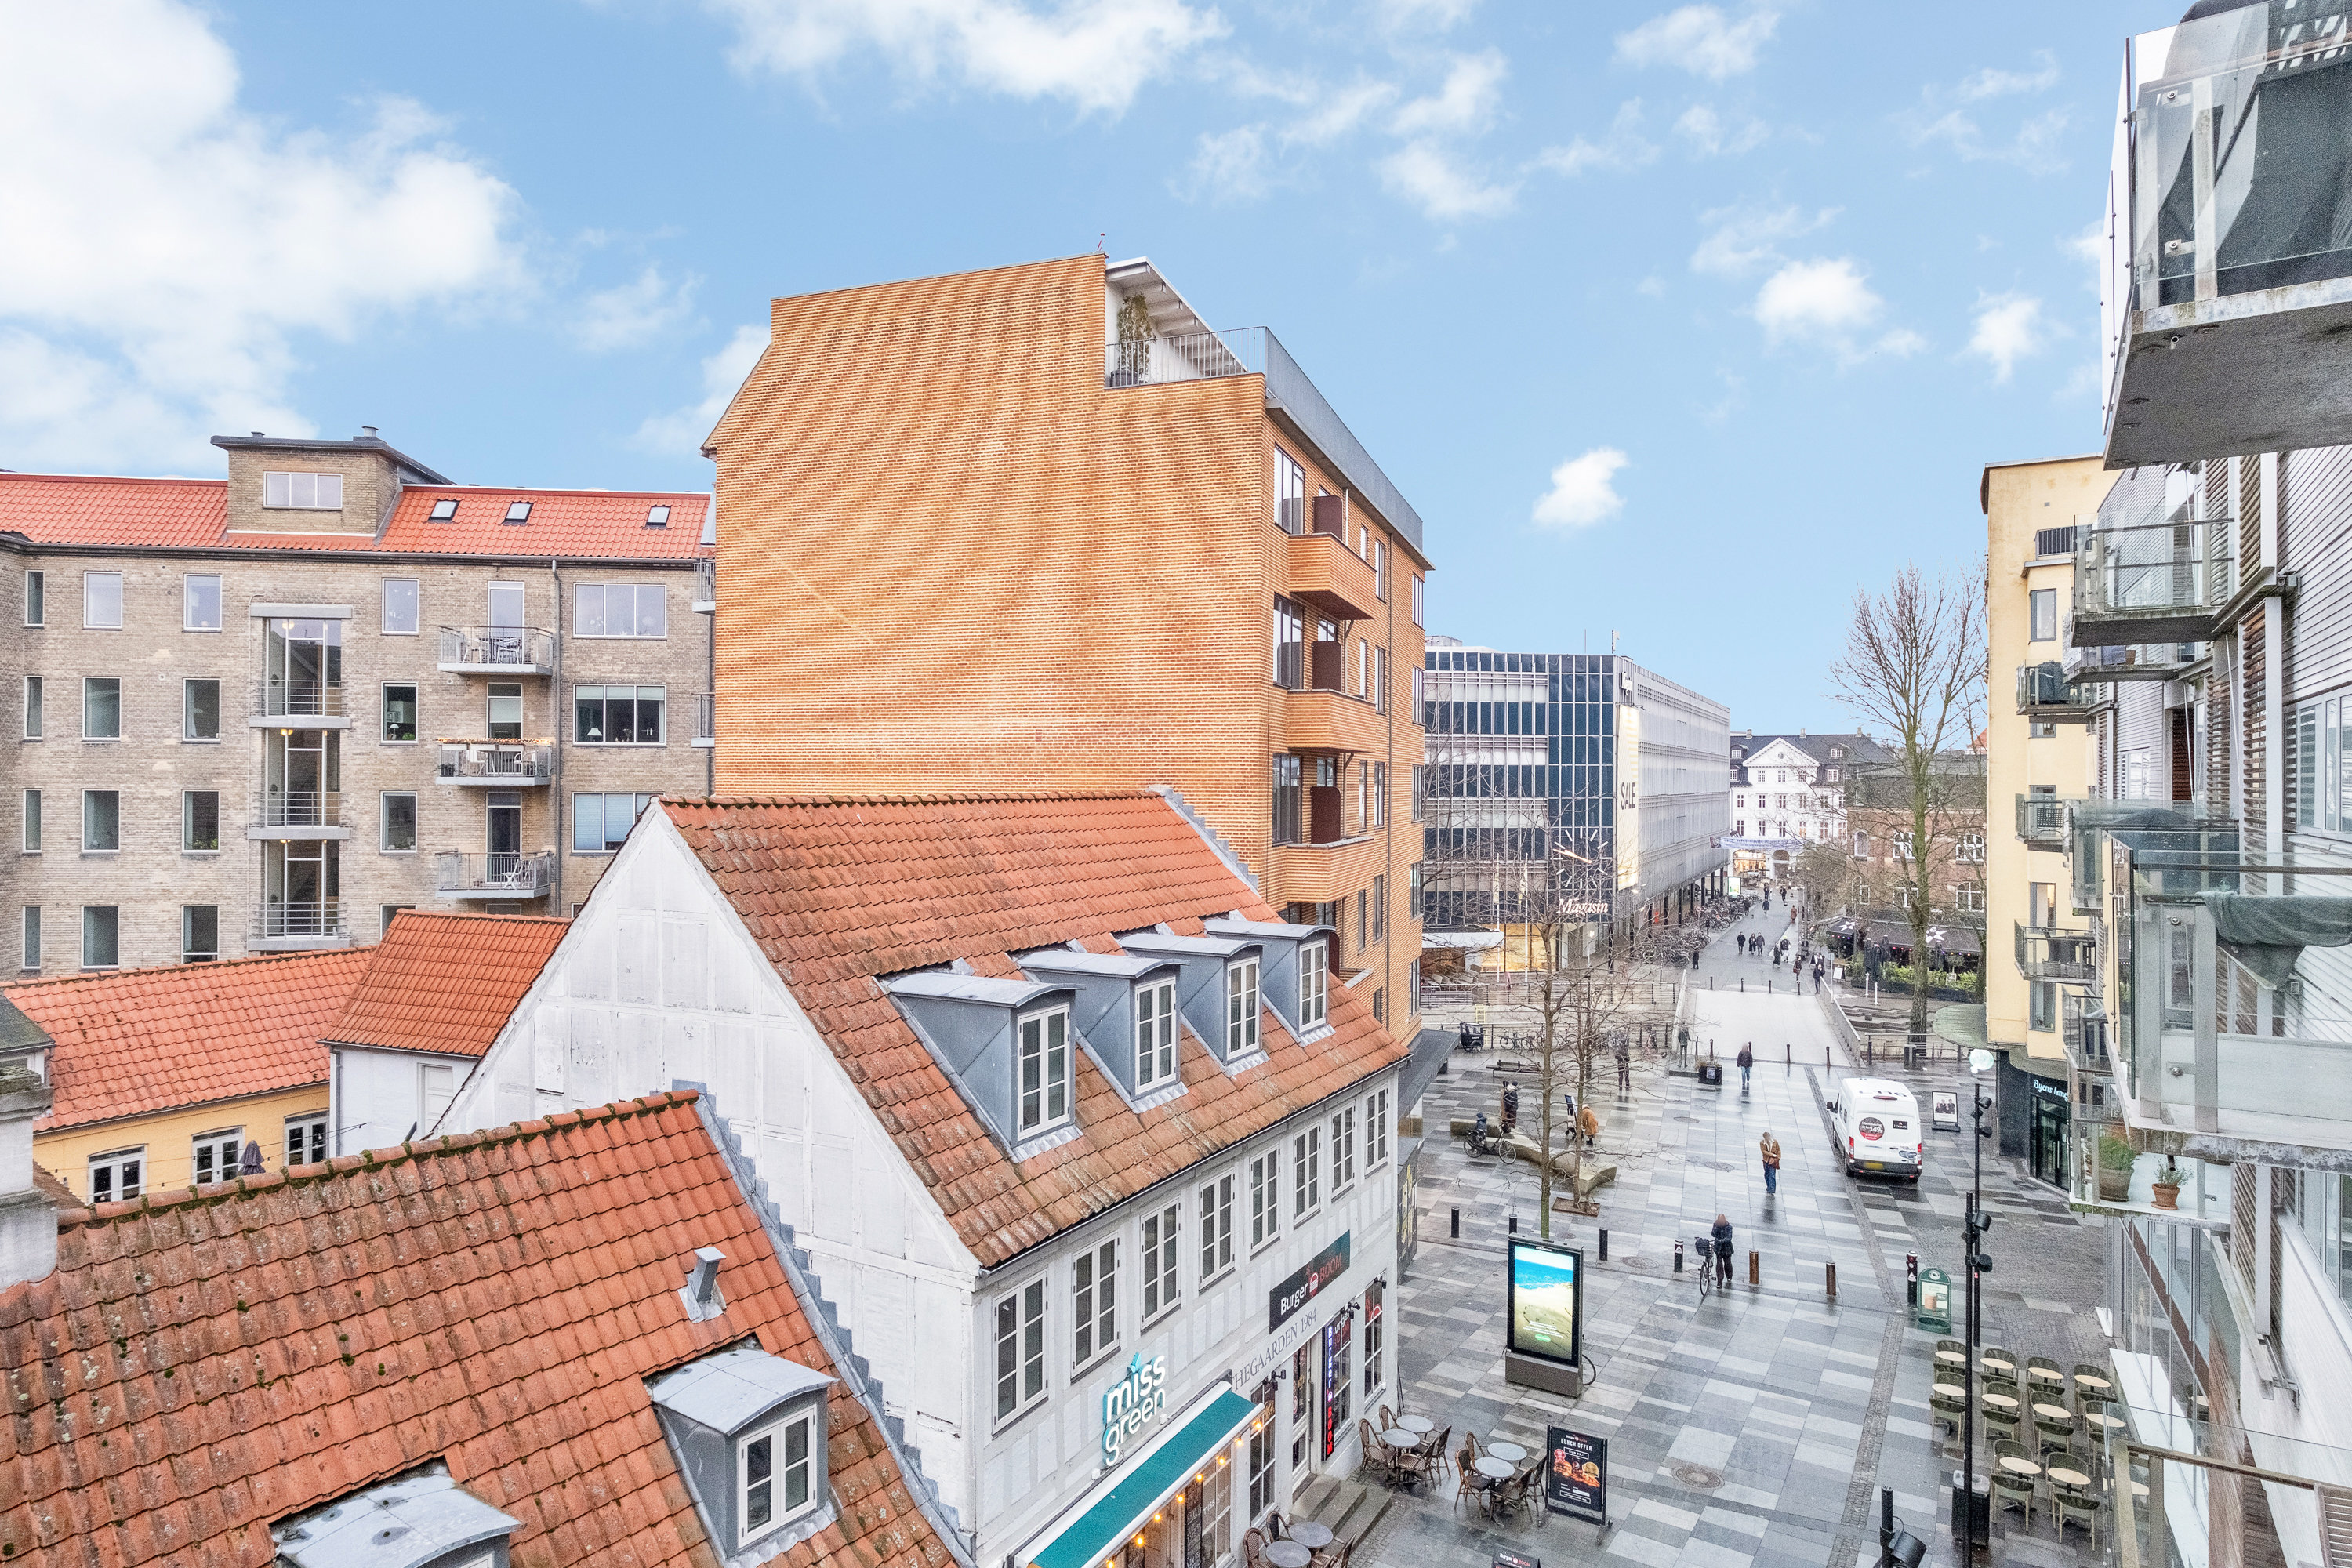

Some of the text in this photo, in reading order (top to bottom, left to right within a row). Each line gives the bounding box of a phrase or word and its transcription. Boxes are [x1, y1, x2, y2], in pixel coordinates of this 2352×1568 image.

[1621, 782, 1636, 810] SALE
[1556, 898, 1609, 917] Magasin
[2033, 1080, 2053, 1093] Byens
[1280, 1253, 1342, 1316] Burger BOOM
[1233, 1307, 1317, 1391] HEGAARDEN 1984
[1104, 1353, 1166, 1424] miss
[1104, 1388, 1166, 1466] green
[1561, 1438, 1592, 1451] LUNCH OFFER
[1202, 1498, 1215, 1516] miss
[1217, 1484, 1230, 1504] green
